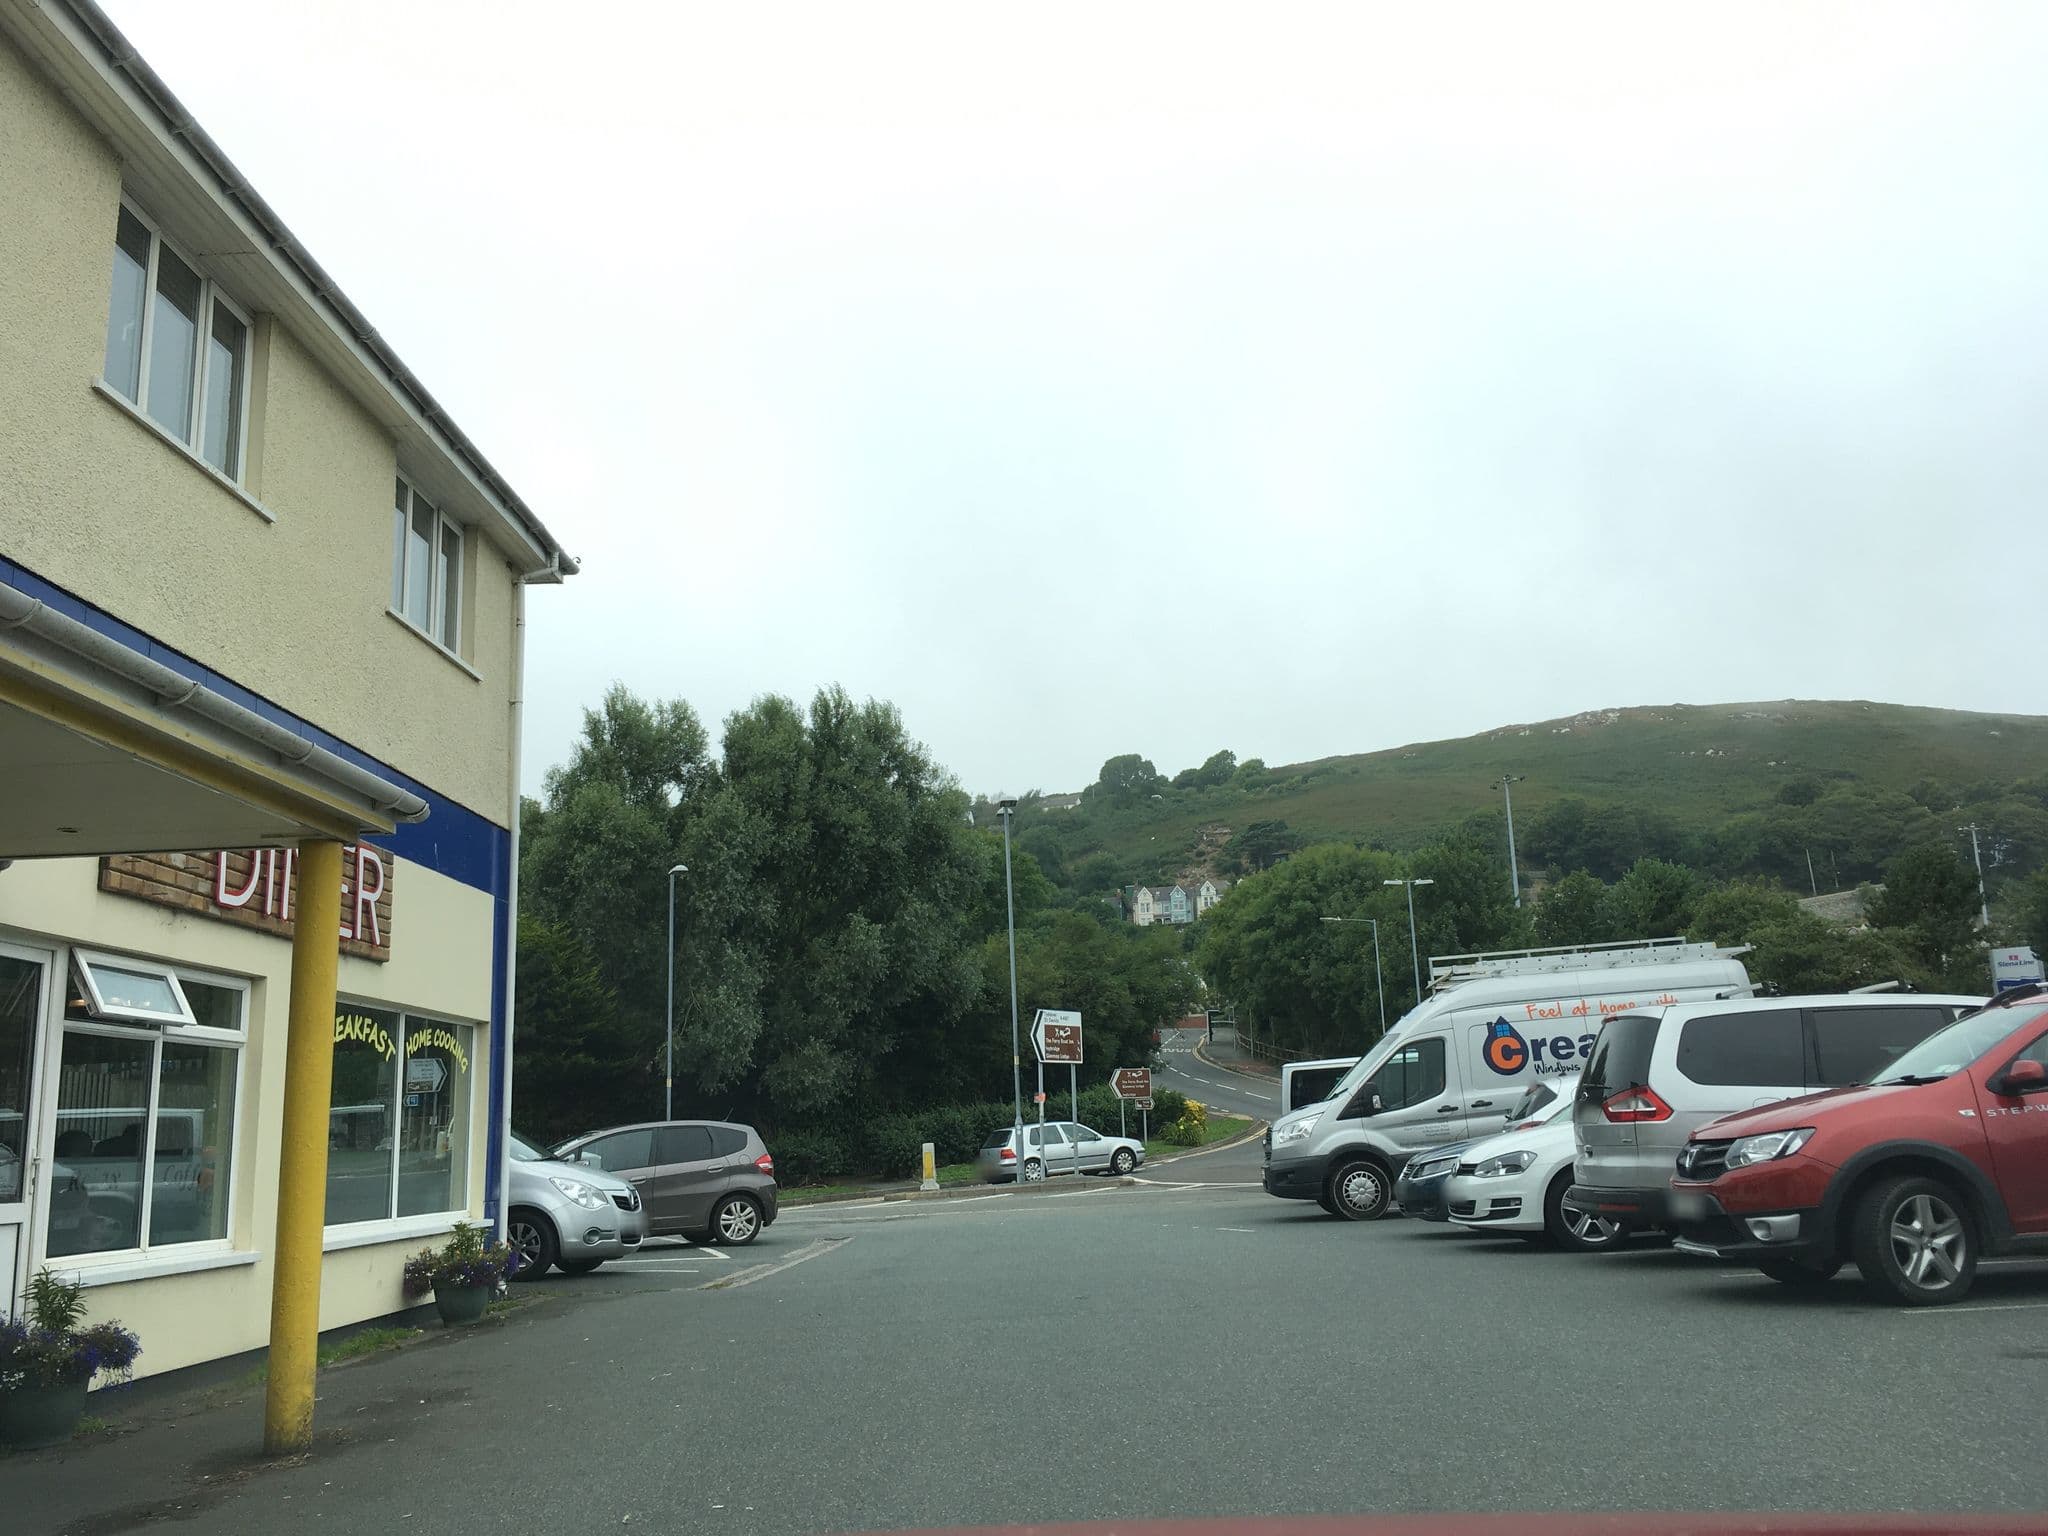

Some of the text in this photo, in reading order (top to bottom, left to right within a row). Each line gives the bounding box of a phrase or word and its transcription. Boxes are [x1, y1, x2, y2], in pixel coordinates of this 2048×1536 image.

[216, 844, 384, 946] DIR
[1525, 1001, 1563, 1020] Feel
[1571, 998, 1591, 1015] at
[334, 1014, 396, 1062] EAKFAST
[406, 1028, 432, 1059] HOME
[433, 1028, 469, 1075] COOKING
[1534, 1061, 1581, 1075] Windows
